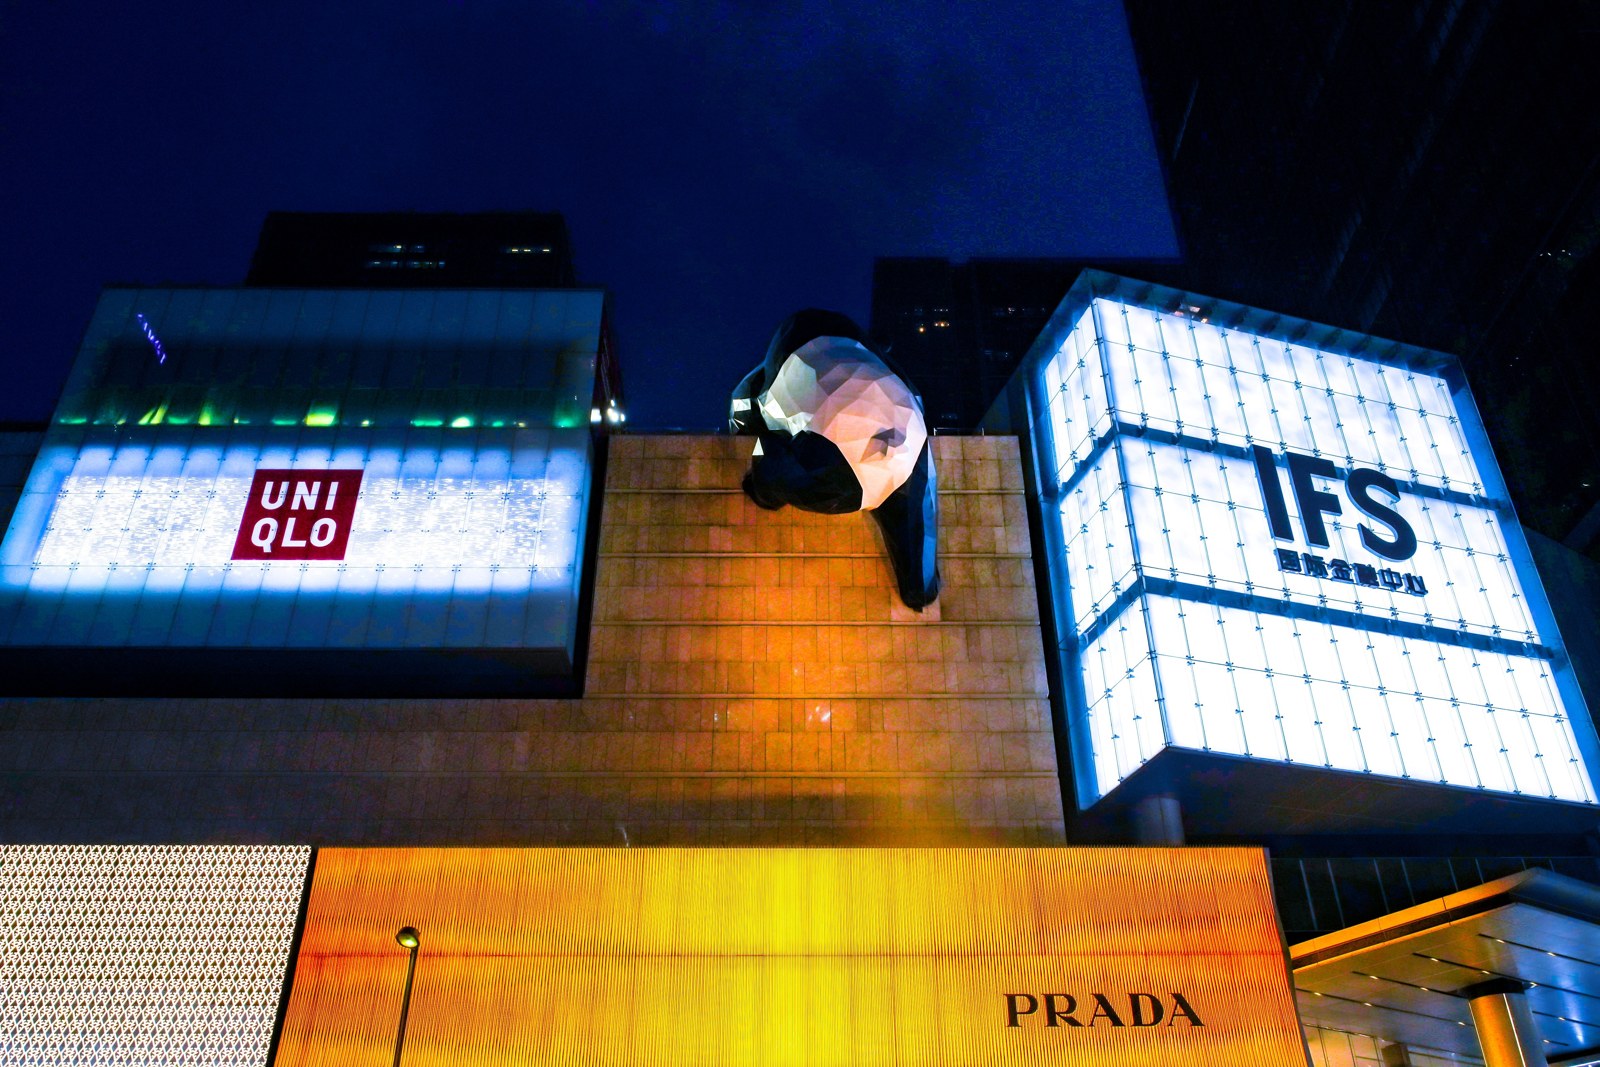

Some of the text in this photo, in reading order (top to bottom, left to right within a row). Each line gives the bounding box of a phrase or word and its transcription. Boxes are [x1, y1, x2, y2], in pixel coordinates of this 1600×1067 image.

[261, 481, 339, 510] UNI
[1252, 443, 1418, 562] IFS
[251, 517, 337, 553] QLO
[1003, 993, 1205, 1027] PRADA
